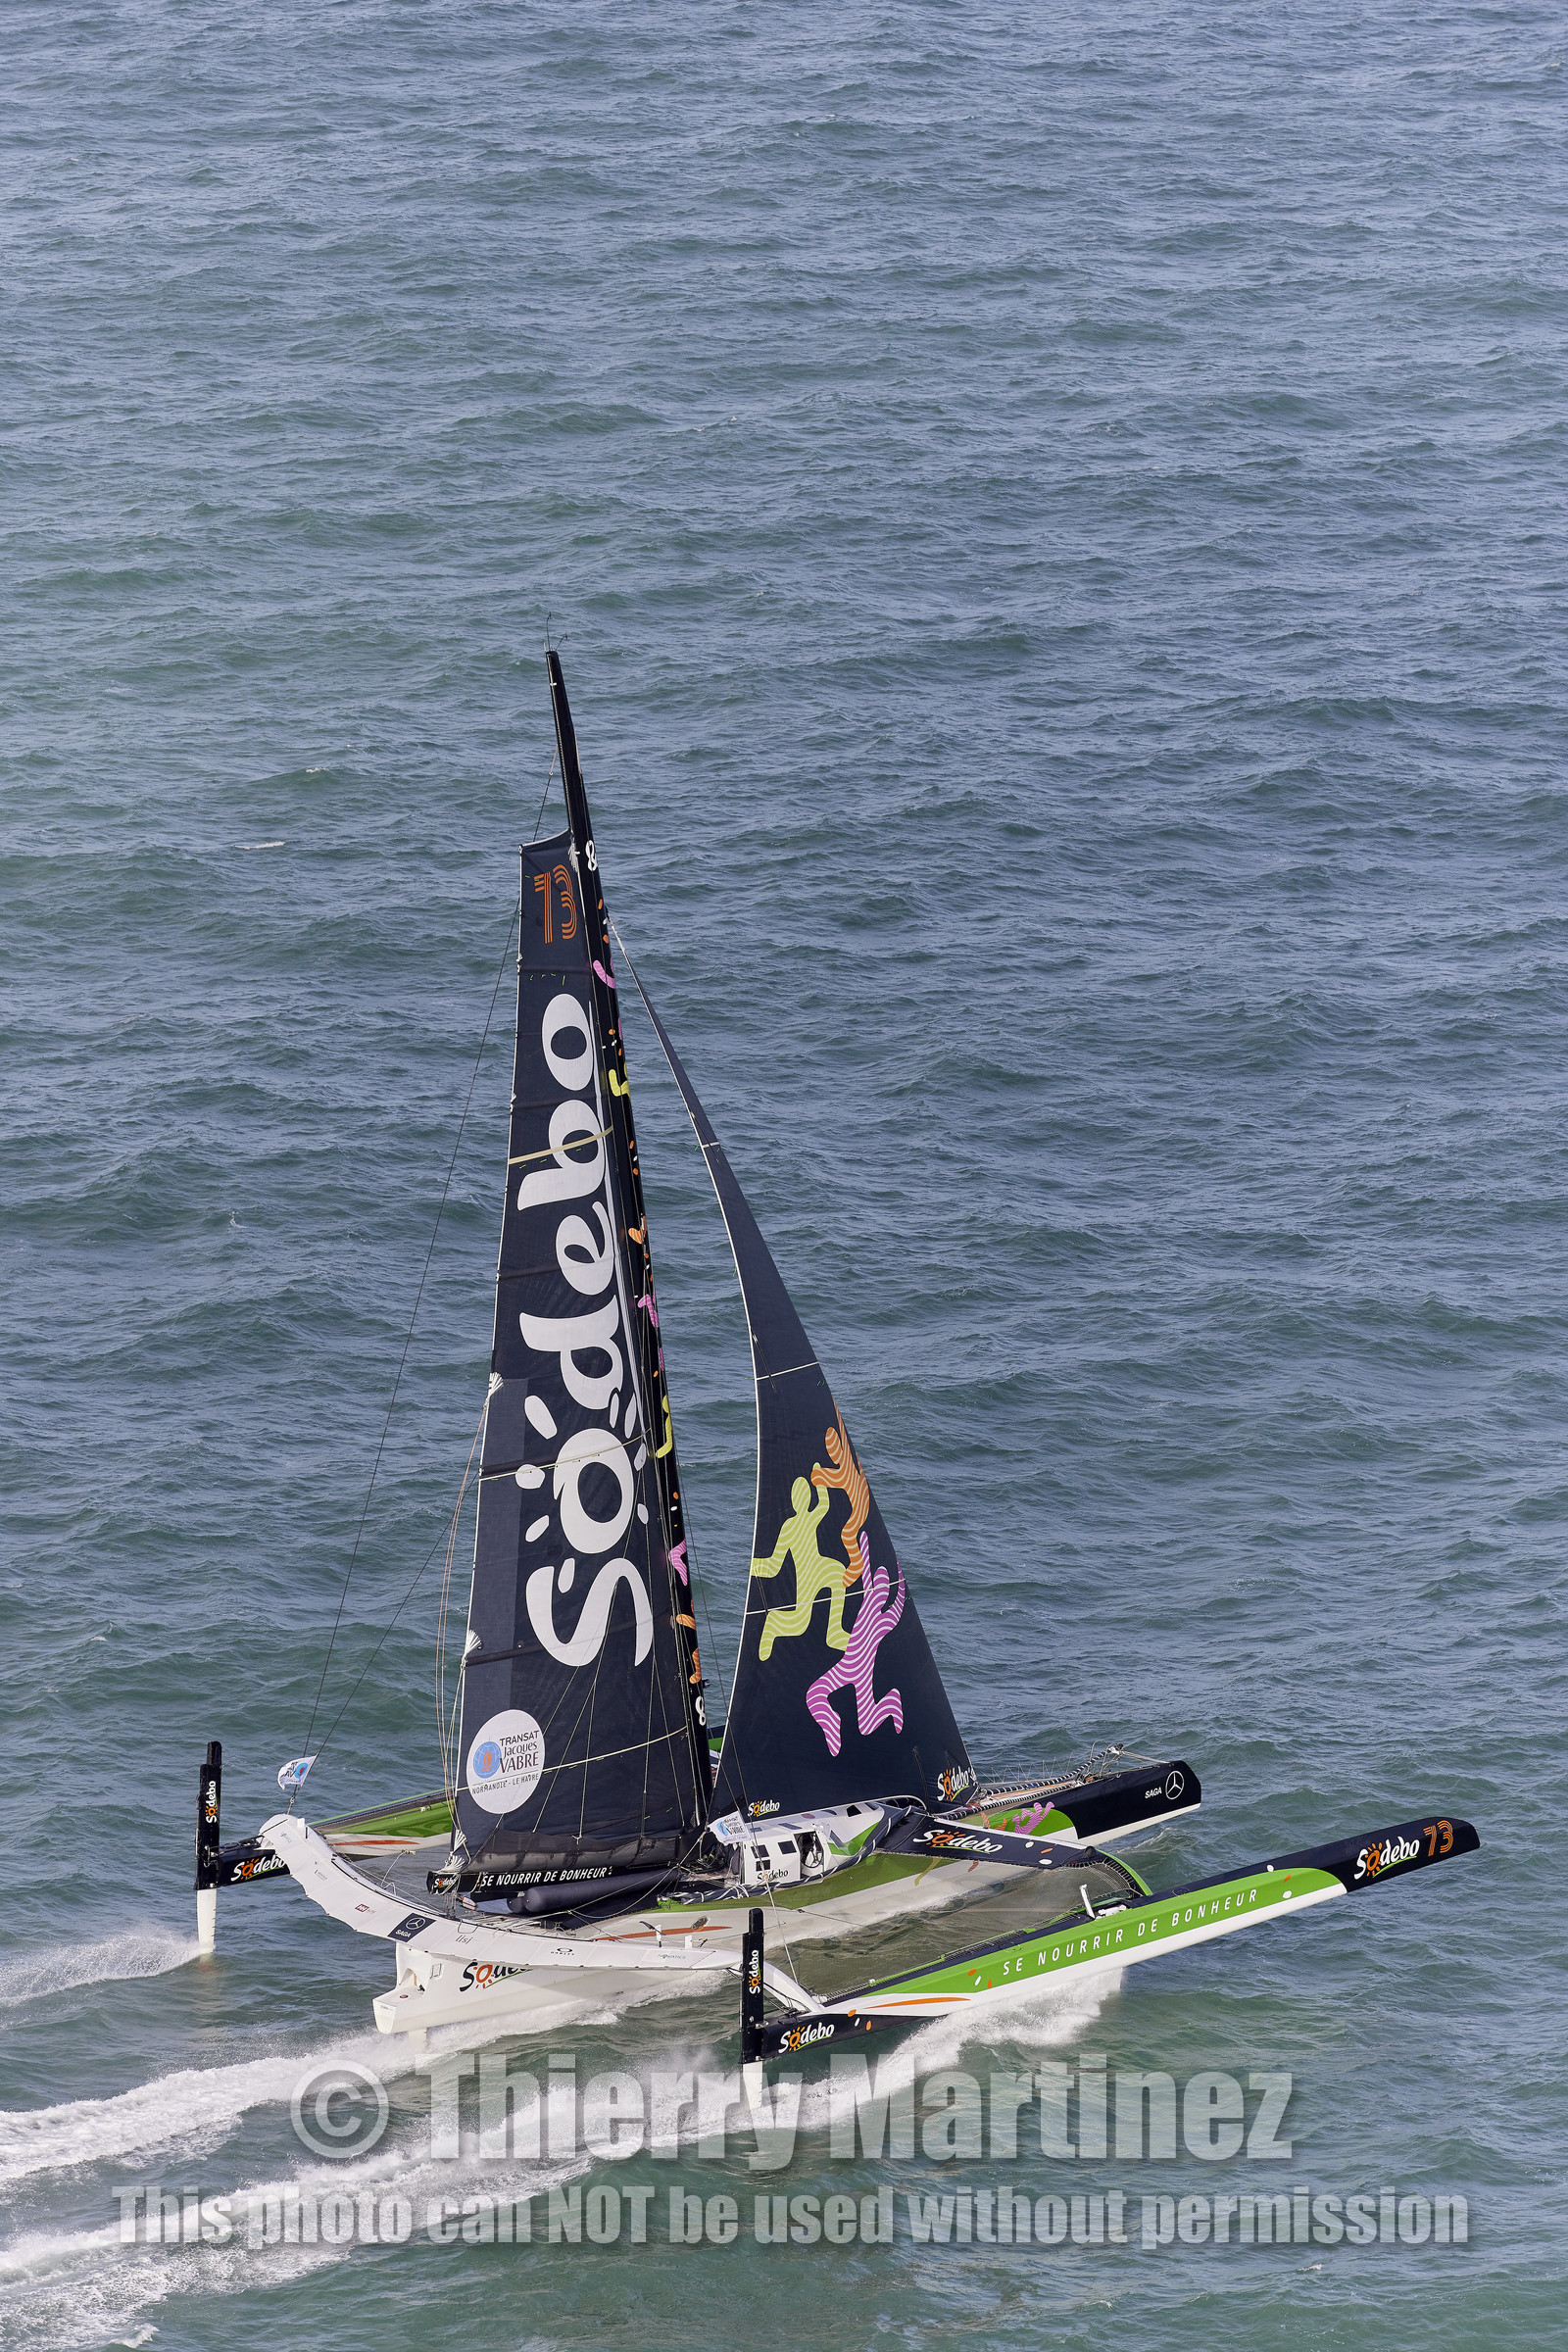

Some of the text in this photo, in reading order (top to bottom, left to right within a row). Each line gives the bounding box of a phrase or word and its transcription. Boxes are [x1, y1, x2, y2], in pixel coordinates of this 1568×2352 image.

[517, 993, 654, 1667] Sodebo
[500, 1730, 539, 1746] TRANSAT
[499, 1751, 539, 1773] VABRE
[937, 1766, 970, 1801] Sodebo
[1145, 1788, 1162, 1799] SAGA
[205, 1780, 218, 1824] Sodebo
[747, 1799, 780, 1817] Sodebo
[913, 1829, 1004, 1853] Sodebo
[1354, 1836, 1421, 1880] Sodebo
[481, 1867, 608, 1887] SE NOURRIR DE BONHEUR
[1003, 1888, 1258, 1976] SE NOURRIR DE BONHEUR
[748, 1949, 760, 1994] Sodebo
[778, 2021, 835, 2054] Sodebo
